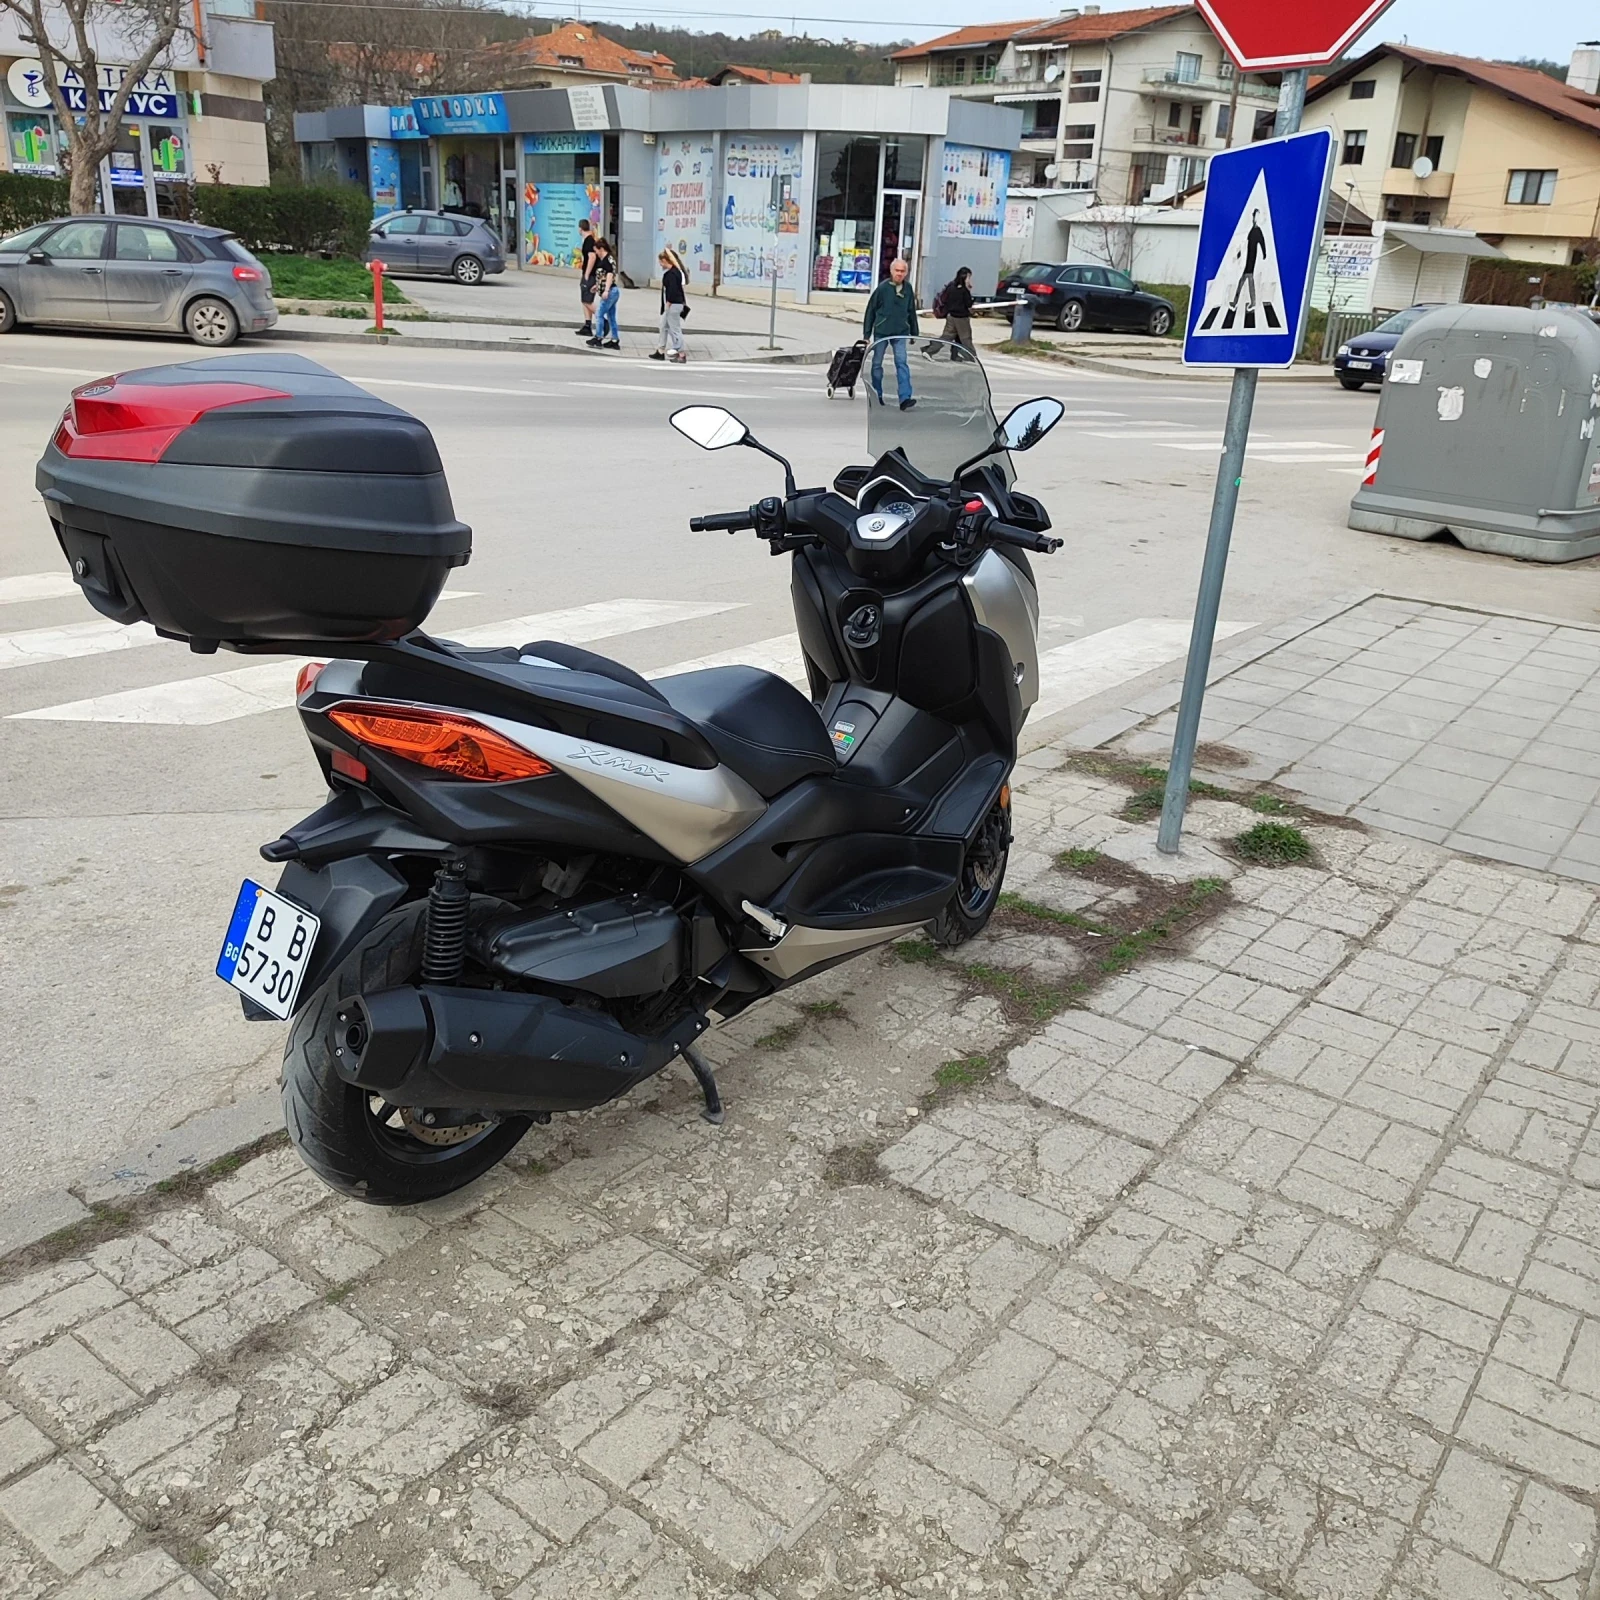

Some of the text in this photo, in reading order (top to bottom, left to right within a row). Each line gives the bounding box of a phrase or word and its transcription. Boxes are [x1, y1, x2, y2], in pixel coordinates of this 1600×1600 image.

[68, 88, 168, 115] ККТУС
[532, 137, 592, 152] КНИЖАРНИЦА
[671, 182, 703, 199] ПЕРИЛНИ
[666, 200, 706, 216] ПРЕПАРАТИ
[257, 906, 307, 962] B B
[224, 941, 239, 962] BG
[237, 942, 294, 1004] 5730
